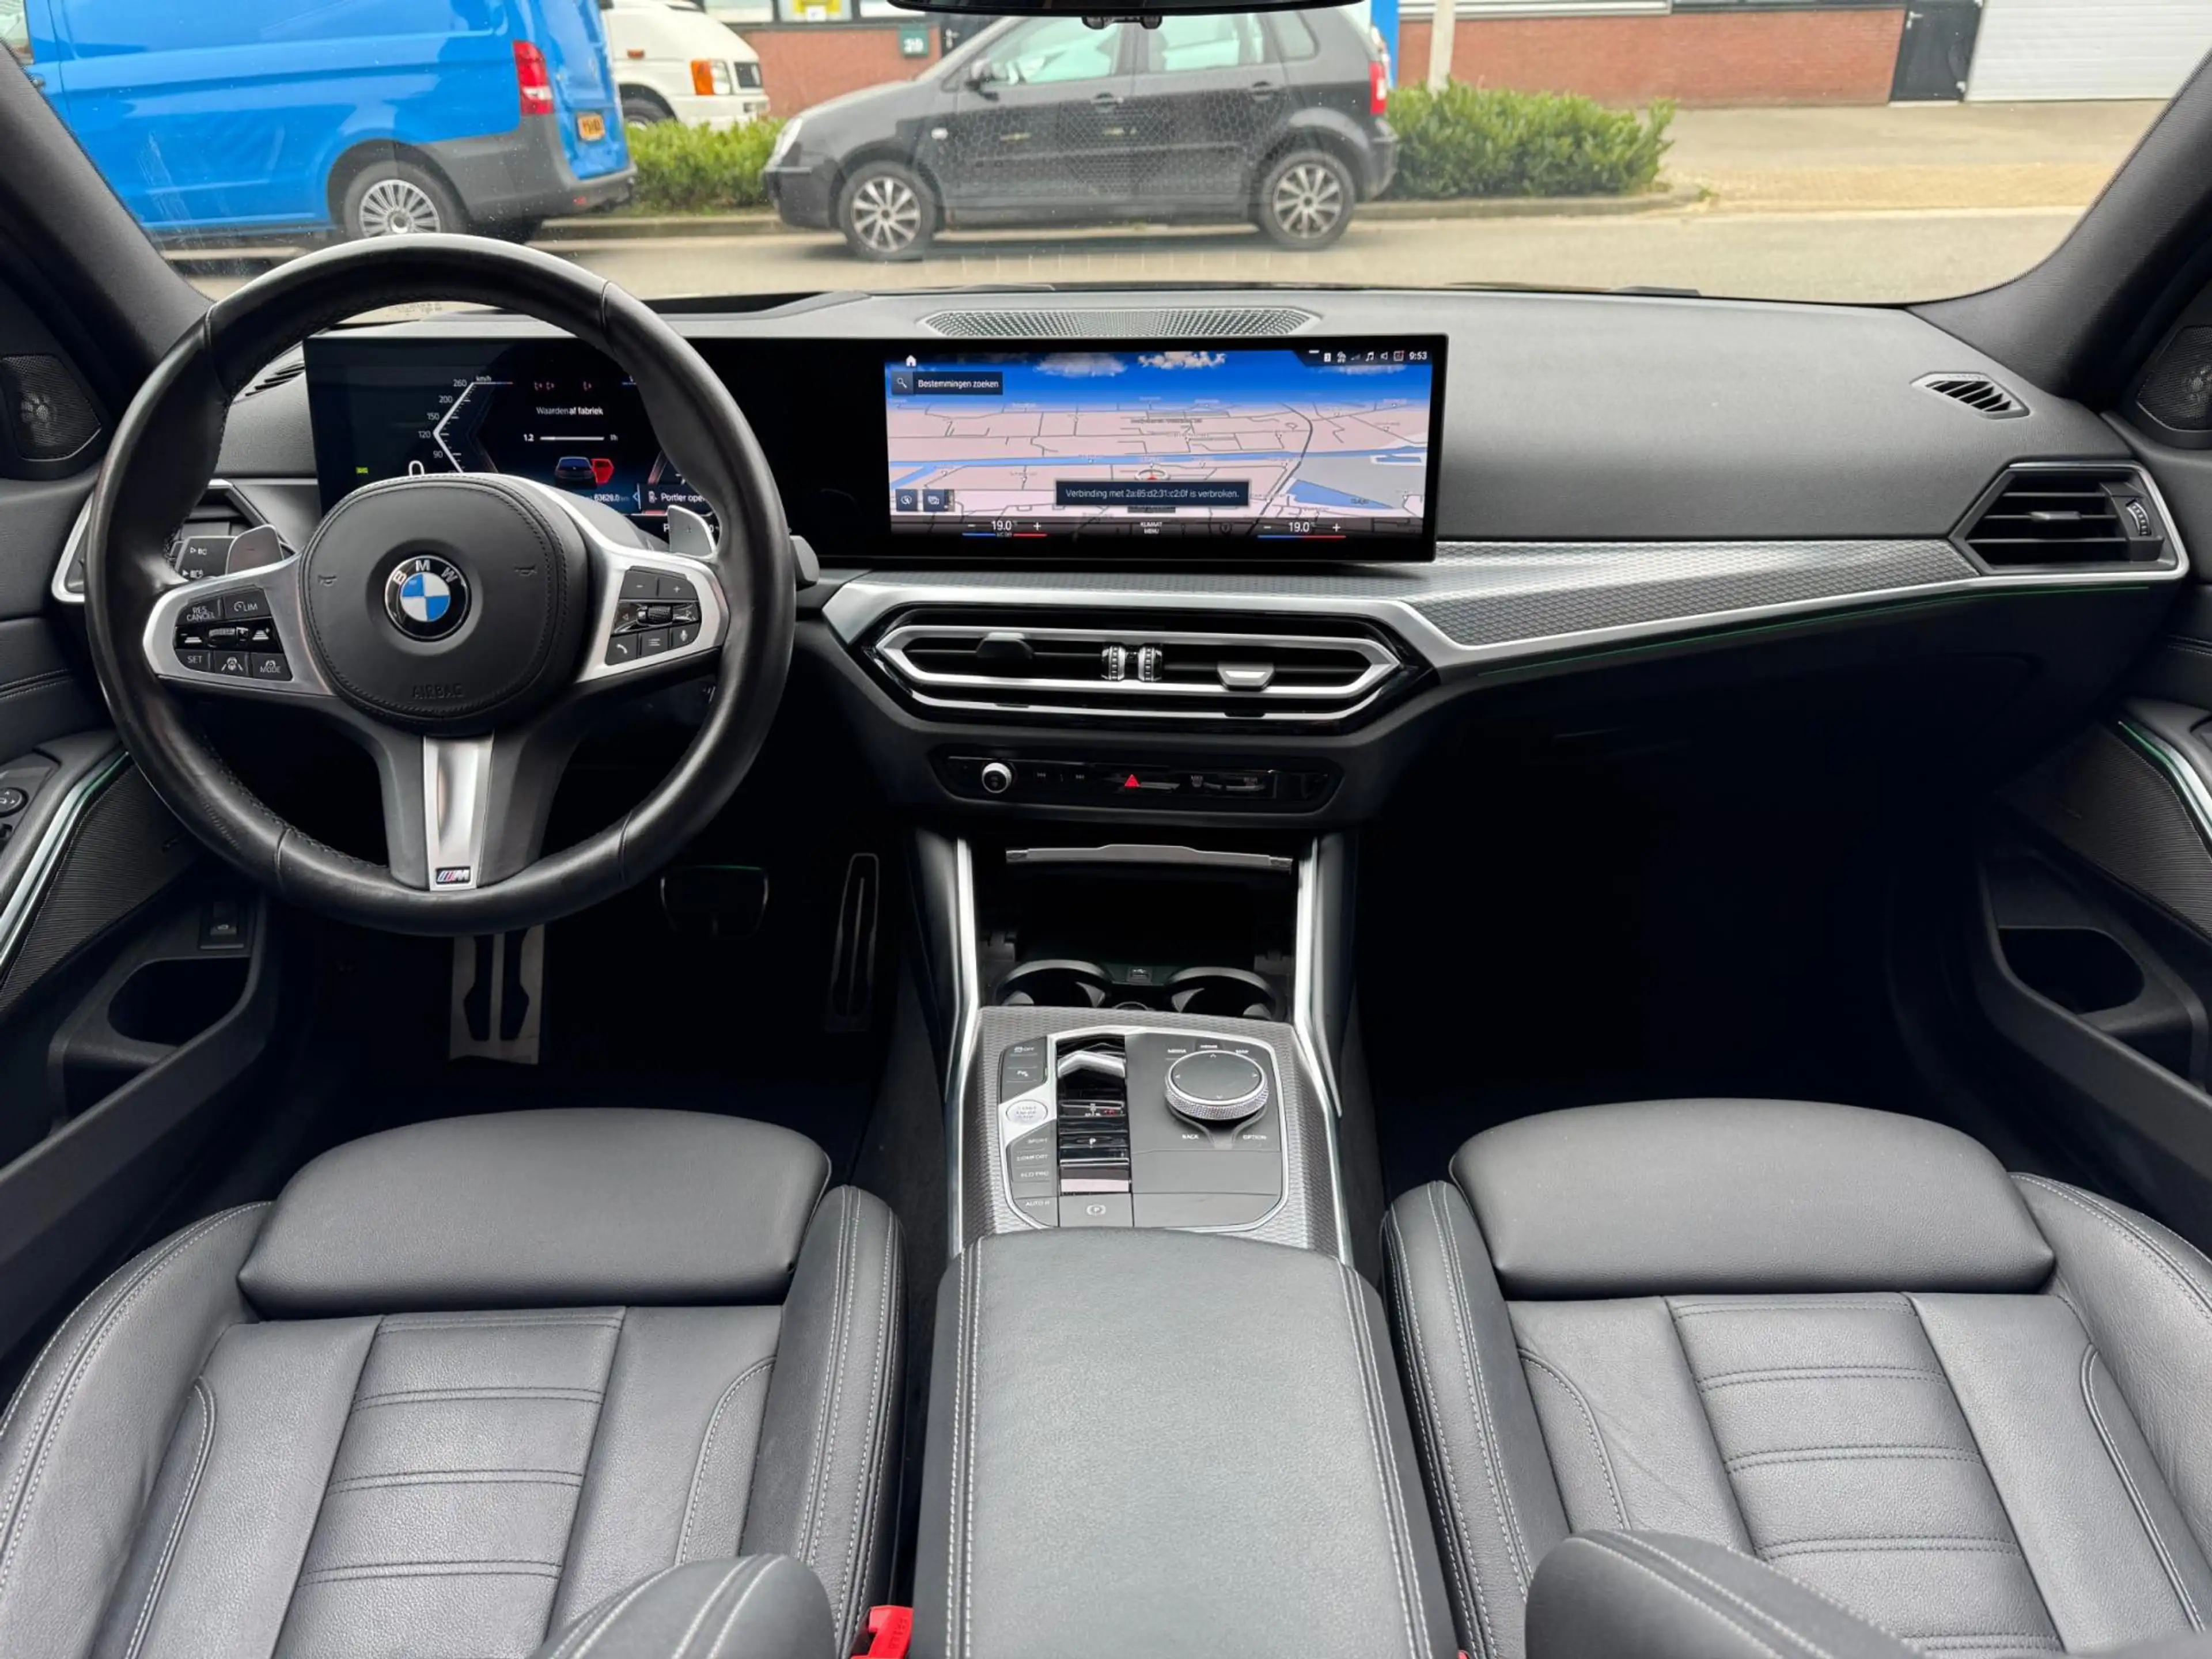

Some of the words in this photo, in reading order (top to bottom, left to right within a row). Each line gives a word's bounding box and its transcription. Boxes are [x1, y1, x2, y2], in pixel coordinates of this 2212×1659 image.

[1409, 351, 1427, 360] 9:53
[453, 379, 467, 387] 260
[918, 380, 971, 389] Bestemmingen
[569, 407, 576, 415] af
[578, 407, 604, 415] fabriek
[661, 492, 685, 502] Portier
[1066, 489, 1107, 499] Verbinding
[1109, 490, 1124, 498] met
[1191, 490, 1197, 498] is
[1199, 489, 1239, 498] verbroken.
[991, 520, 1012, 531] 19.0
[1289, 522, 1310, 532] 19.0
[393, 559, 459, 585] BMW
[243, 603, 257, 612] LIM
[187, 610, 215, 621] CANCEL
[260, 665, 281, 673] MODE
